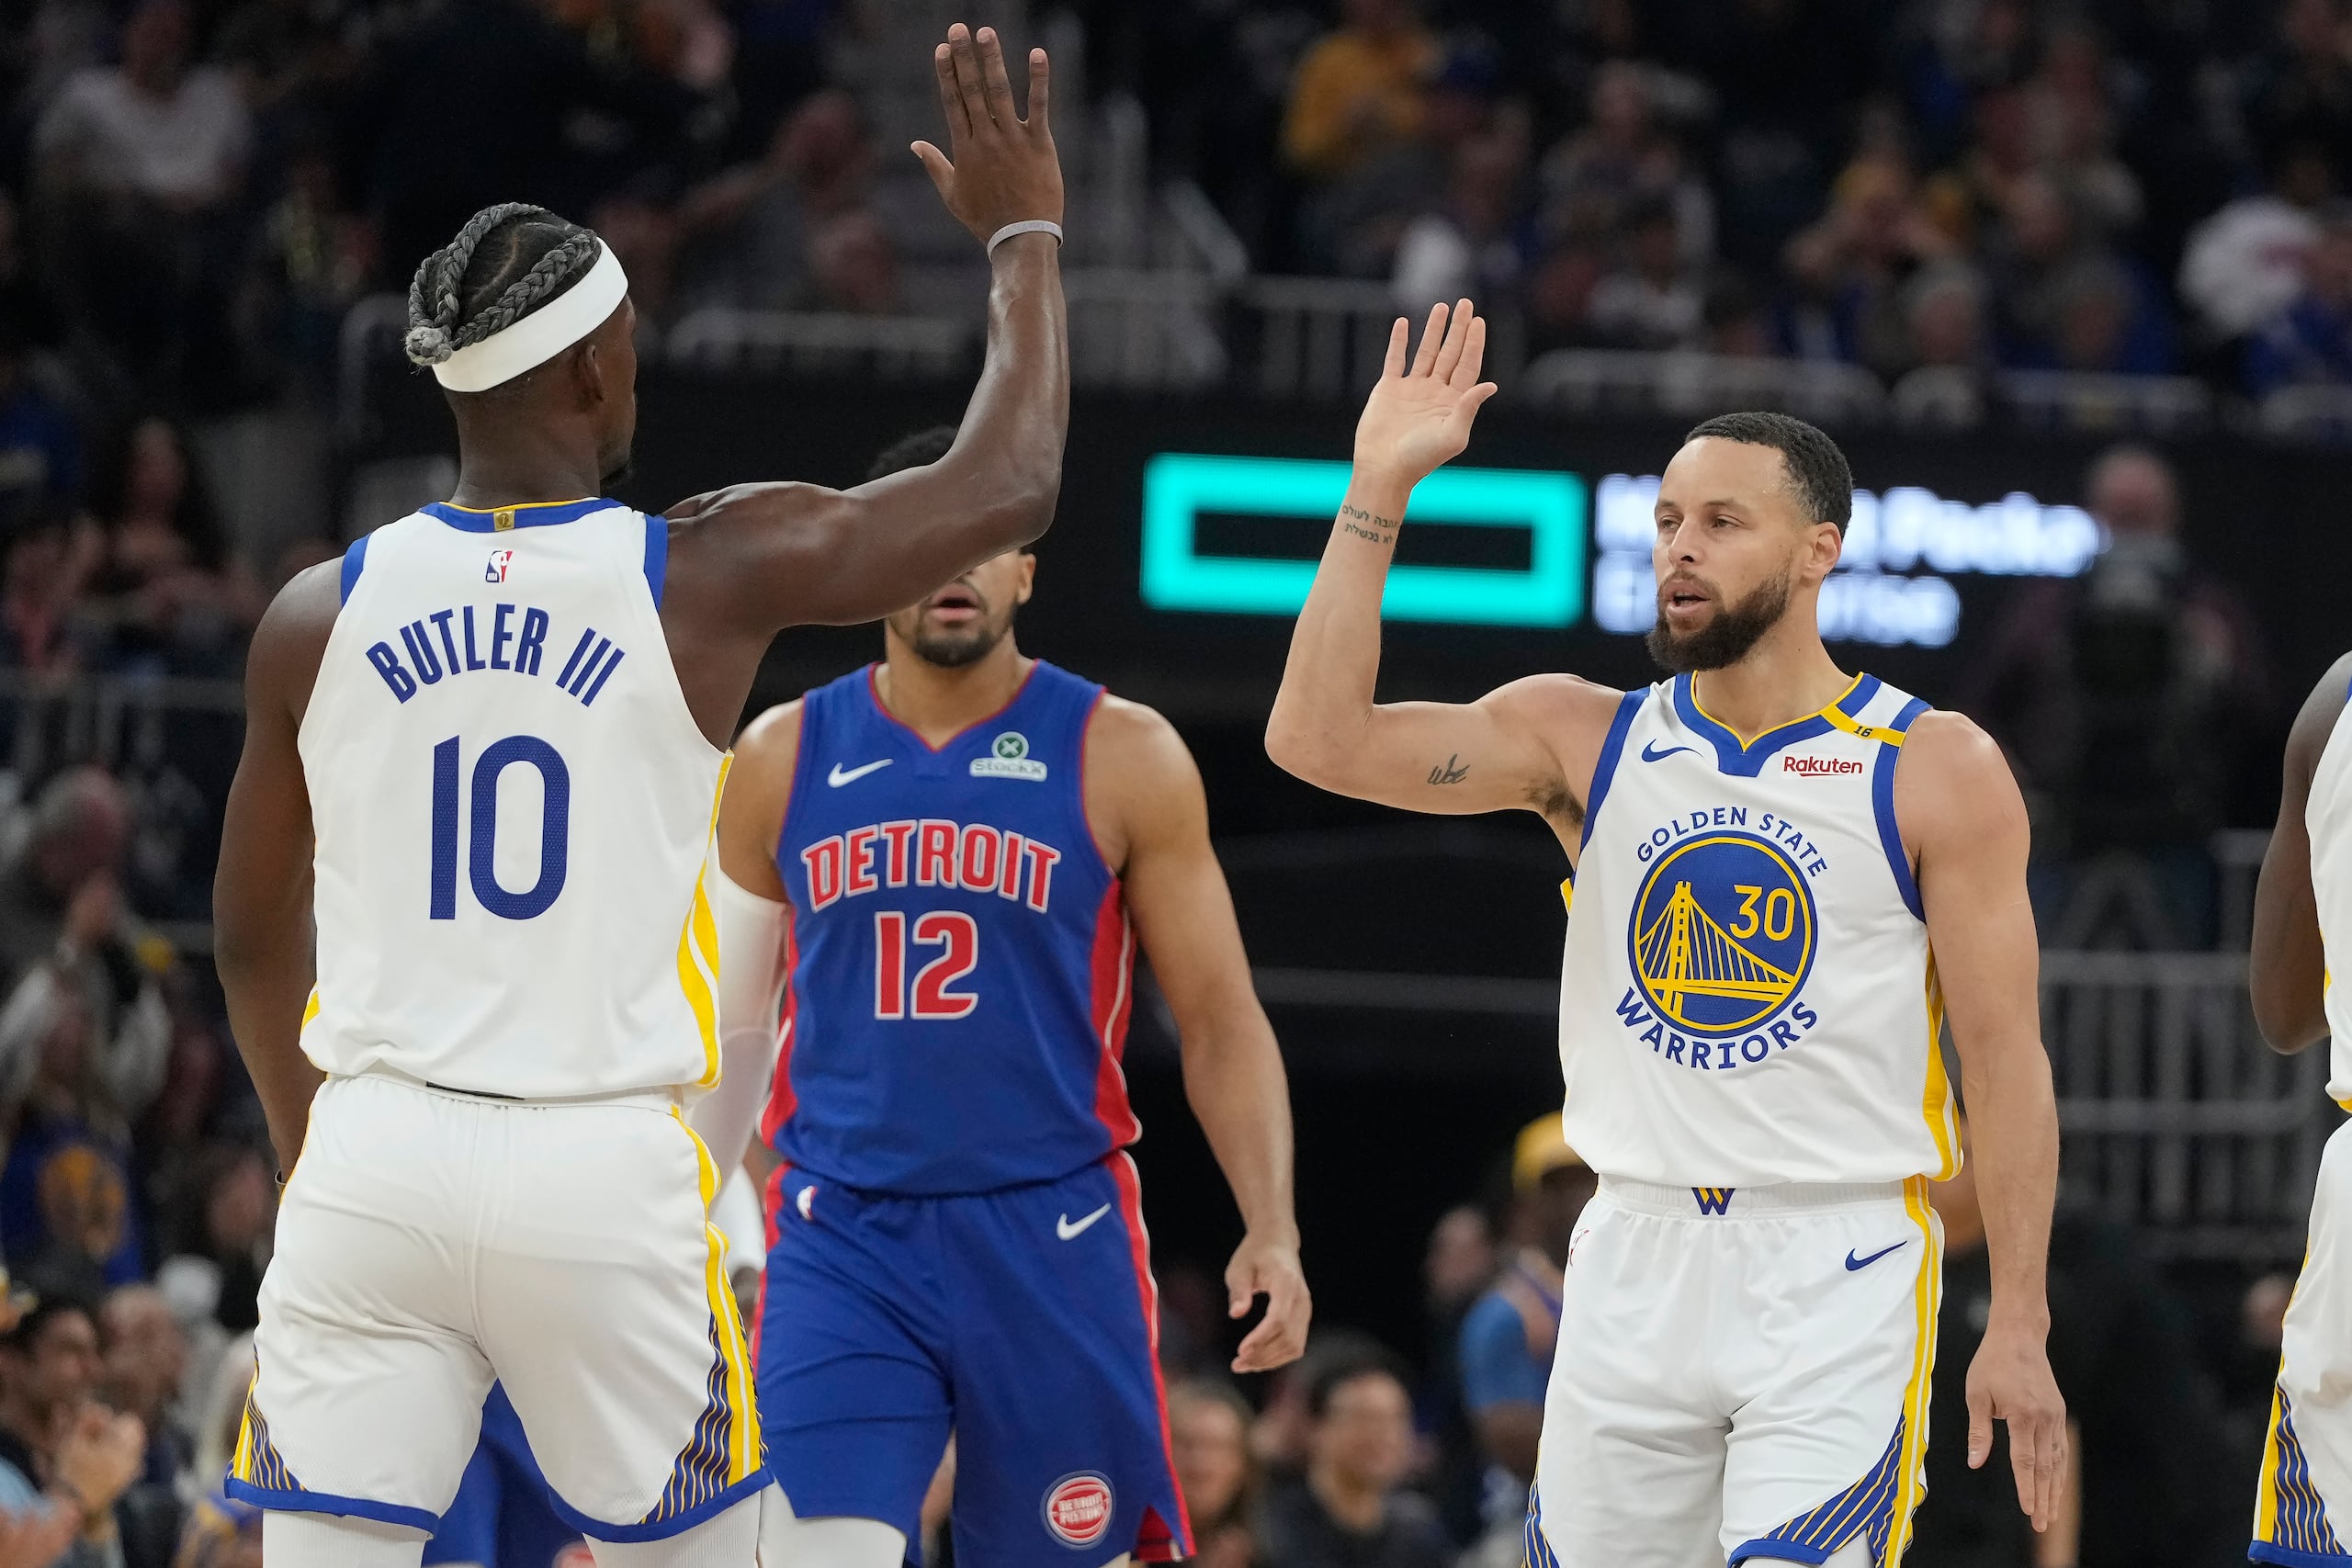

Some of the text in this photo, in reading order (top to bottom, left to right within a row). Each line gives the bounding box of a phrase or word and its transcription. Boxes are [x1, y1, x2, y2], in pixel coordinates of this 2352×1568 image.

[365, 603, 626, 707] BUTLER III
[1783, 756, 1863, 775] Rakuten
[1853, 726, 1873, 738] 16
[429, 734, 571, 919] 10
[800, 818, 1061, 913] DETROIT
[1637, 807, 1827, 877] GOLDEN STATE
[1729, 885, 1796, 942] 30
[874, 910, 979, 1021] 12
[1615, 986, 1817, 1070] WARRIORS
